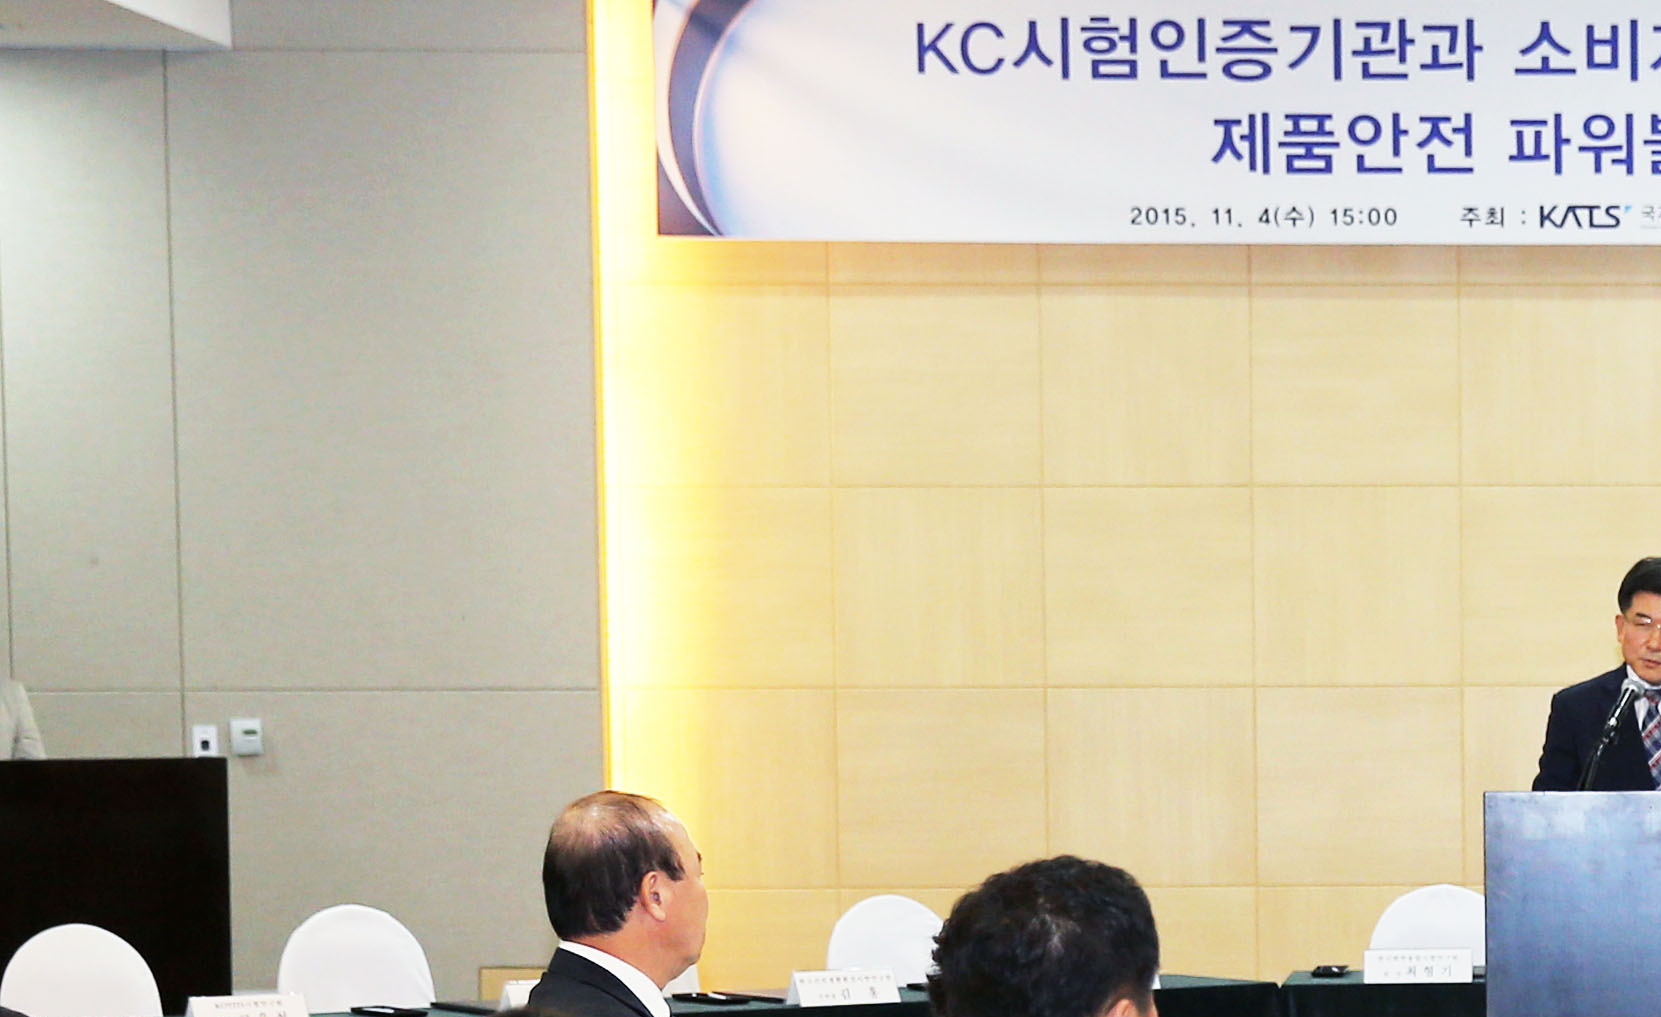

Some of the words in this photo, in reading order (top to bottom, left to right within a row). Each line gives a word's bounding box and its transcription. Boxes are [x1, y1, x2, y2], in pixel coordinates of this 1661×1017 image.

[917, 16, 1484, 82] KC시험인증기관과
[1211, 111, 1475, 176] 제품안전
[1130, 206, 1196, 228] 2015.
[1258, 206, 1315, 228] 4(수)
[1330, 207, 1398, 227] 15:00
[1460, 206, 1505, 229] 주최
[1539, 205, 1621, 229] KATS
